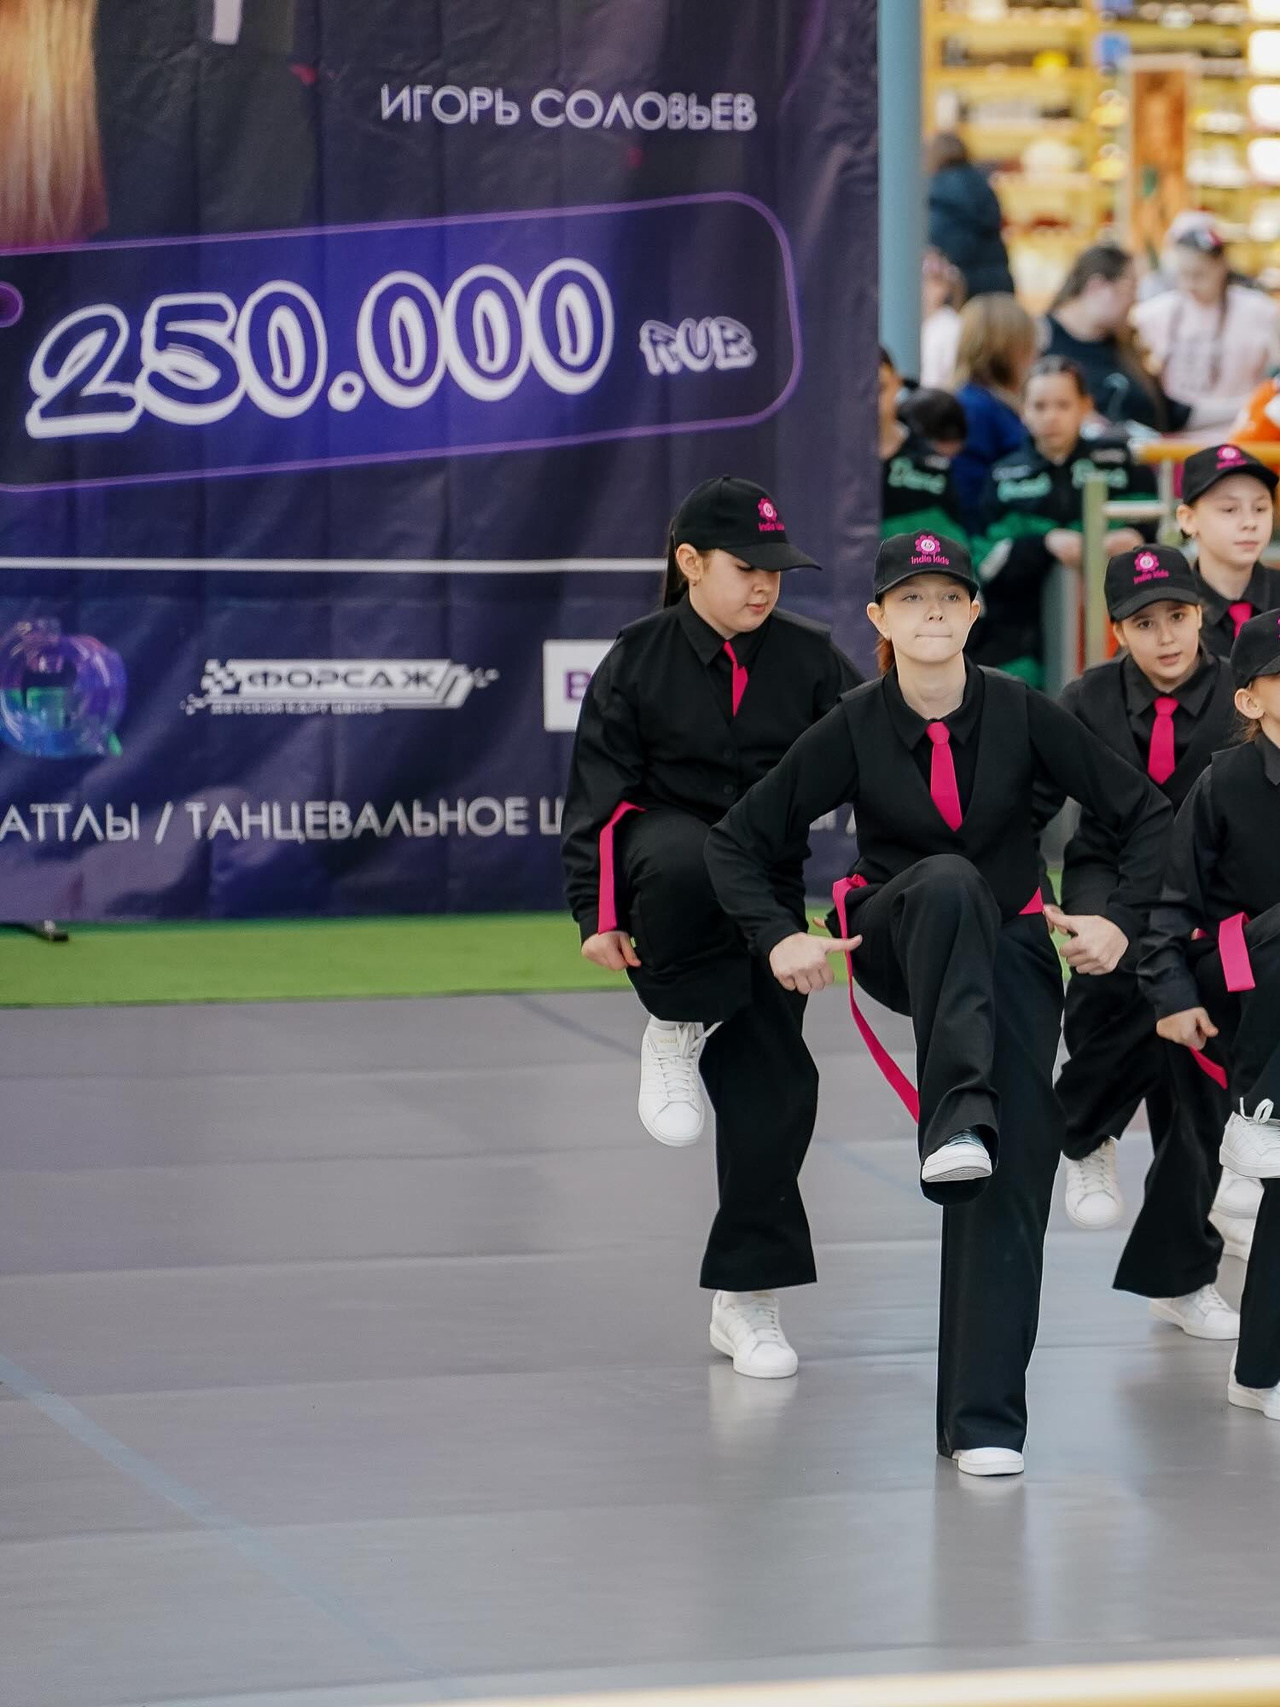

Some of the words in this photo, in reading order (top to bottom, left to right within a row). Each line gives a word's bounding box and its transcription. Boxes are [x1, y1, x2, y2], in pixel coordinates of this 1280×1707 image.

[380, 83, 521, 126] ИГОРЬ
[530, 88, 758, 132] СОЛОВЬЕВ
[25, 257, 614, 439] 250.000
[639, 315, 757, 376] RUB
[248, 668, 434, 689] ФОРСАЖ
[185, 796, 530, 844] ТАНЦЕВАЛЬНОЕ
